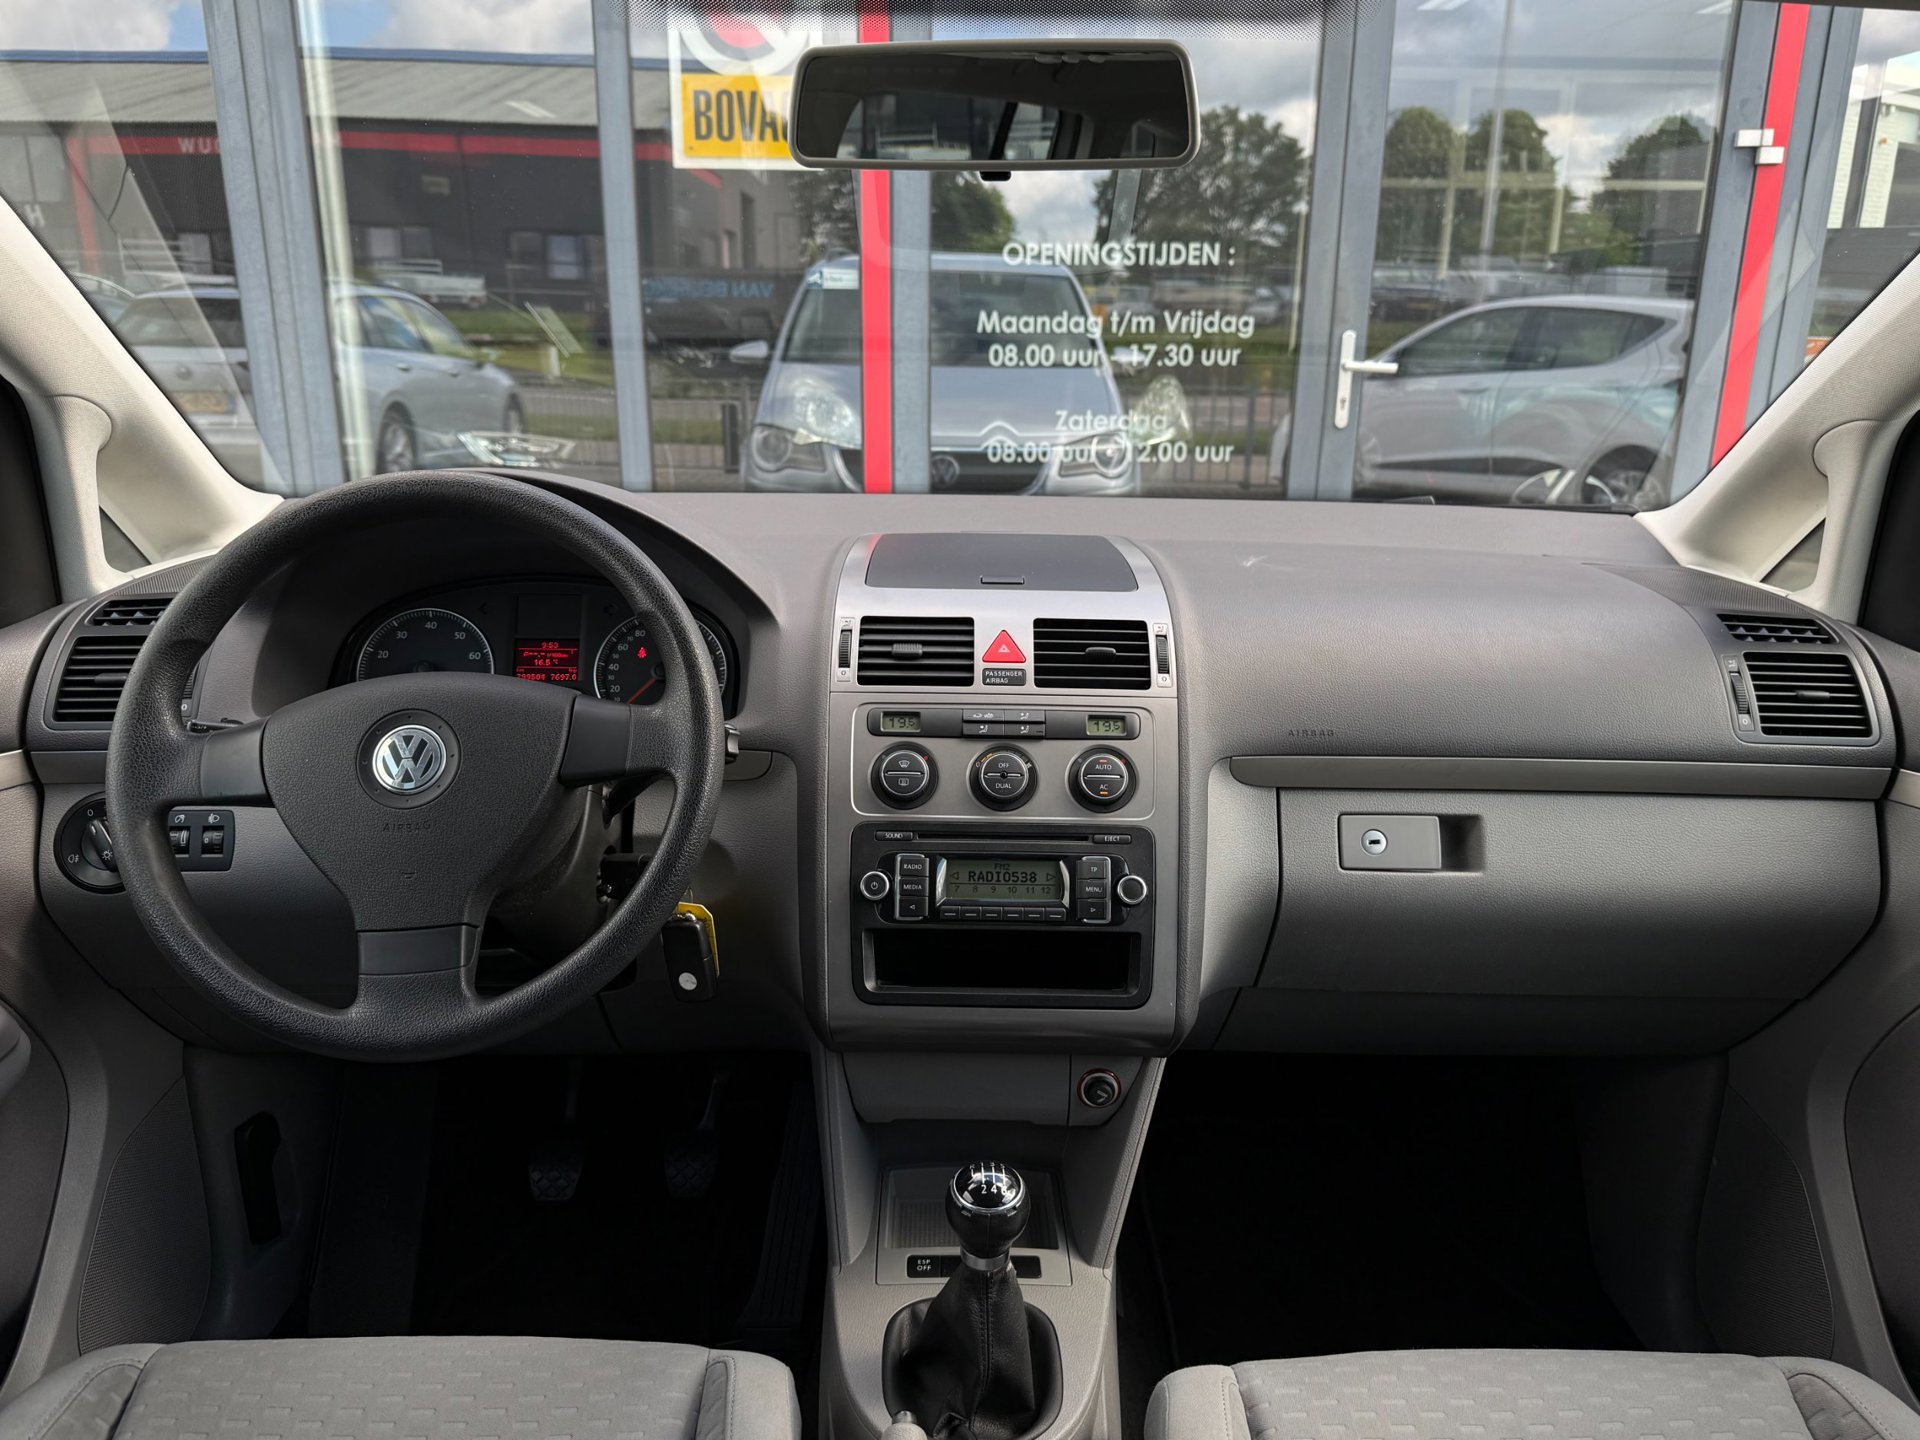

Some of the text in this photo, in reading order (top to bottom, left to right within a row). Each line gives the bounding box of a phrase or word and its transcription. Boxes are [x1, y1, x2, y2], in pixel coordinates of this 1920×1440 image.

[692, 89, 789, 142] BOVA
[1002, 243, 1221, 266] OPENINGSTIJDEN
[977, 310, 1256, 338] Maandag t/m Vrijdag
[988, 344, 1055, 367] 08.00
[1063, 349, 1101, 367] uur
[1130, 344, 1194, 367] 17.30
[1202, 348, 1242, 367] uur
[1055, 410, 1168, 436] Zaterdag
[987, 441, 1050, 463] 08.00
[1195, 444, 1235, 463] uur
[424, 621, 438, 630] 40
[396, 631, 408, 639] 30
[454, 631, 466, 640] 50
[634, 629, 646, 638] 80
[617, 643, 629, 651] 60
[377, 650, 389, 659] 20
[469, 651, 481, 660] 60
[608, 663, 620, 671] 40
[609, 685, 620, 693] 20
[1007, 886, 1018, 895] 10
[1041, 887, 1052, 895] 12
[981, 1184, 988, 1194] 2
[990, 1184, 998, 1195] 4
